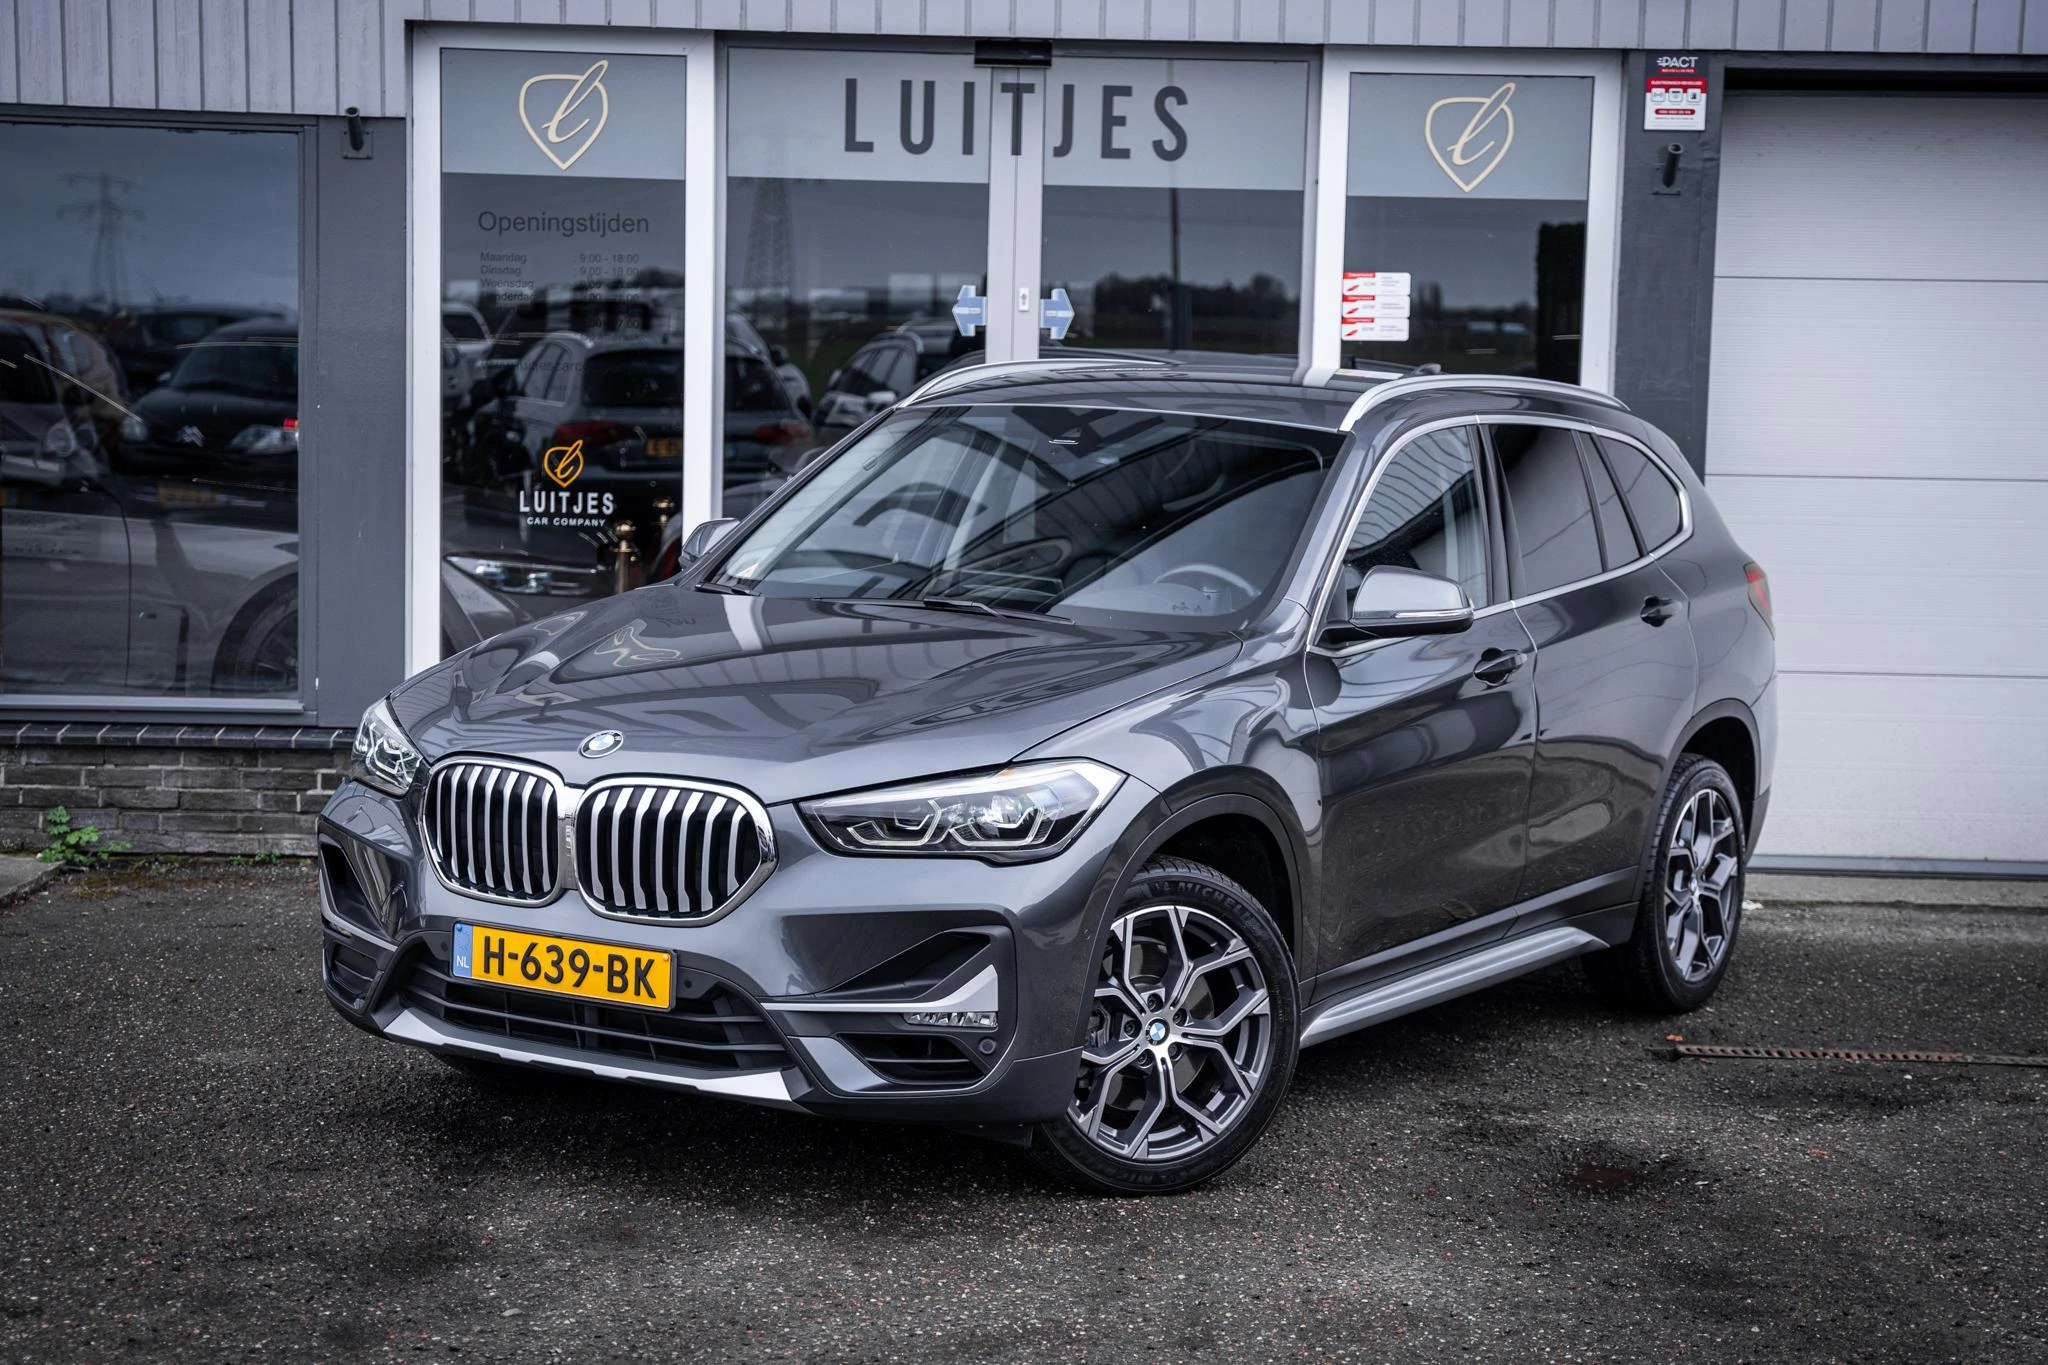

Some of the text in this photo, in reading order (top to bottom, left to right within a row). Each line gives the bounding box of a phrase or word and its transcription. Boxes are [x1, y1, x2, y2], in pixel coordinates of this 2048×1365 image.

[844, 78, 1189, 161] LUITJES
[478, 210, 650, 238] Openingstijden
[481, 252, 527, 264] Maandag
[580, 254, 602, 263] 9:00
[613, 254, 639, 263] 18:00
[519, 490, 614, 515] LUITJES
[527, 516, 606, 527] CAR COMPANY
[1177, 881, 1260, 930] MICHELI
[456, 935, 657, 999] NL H-639-BK
